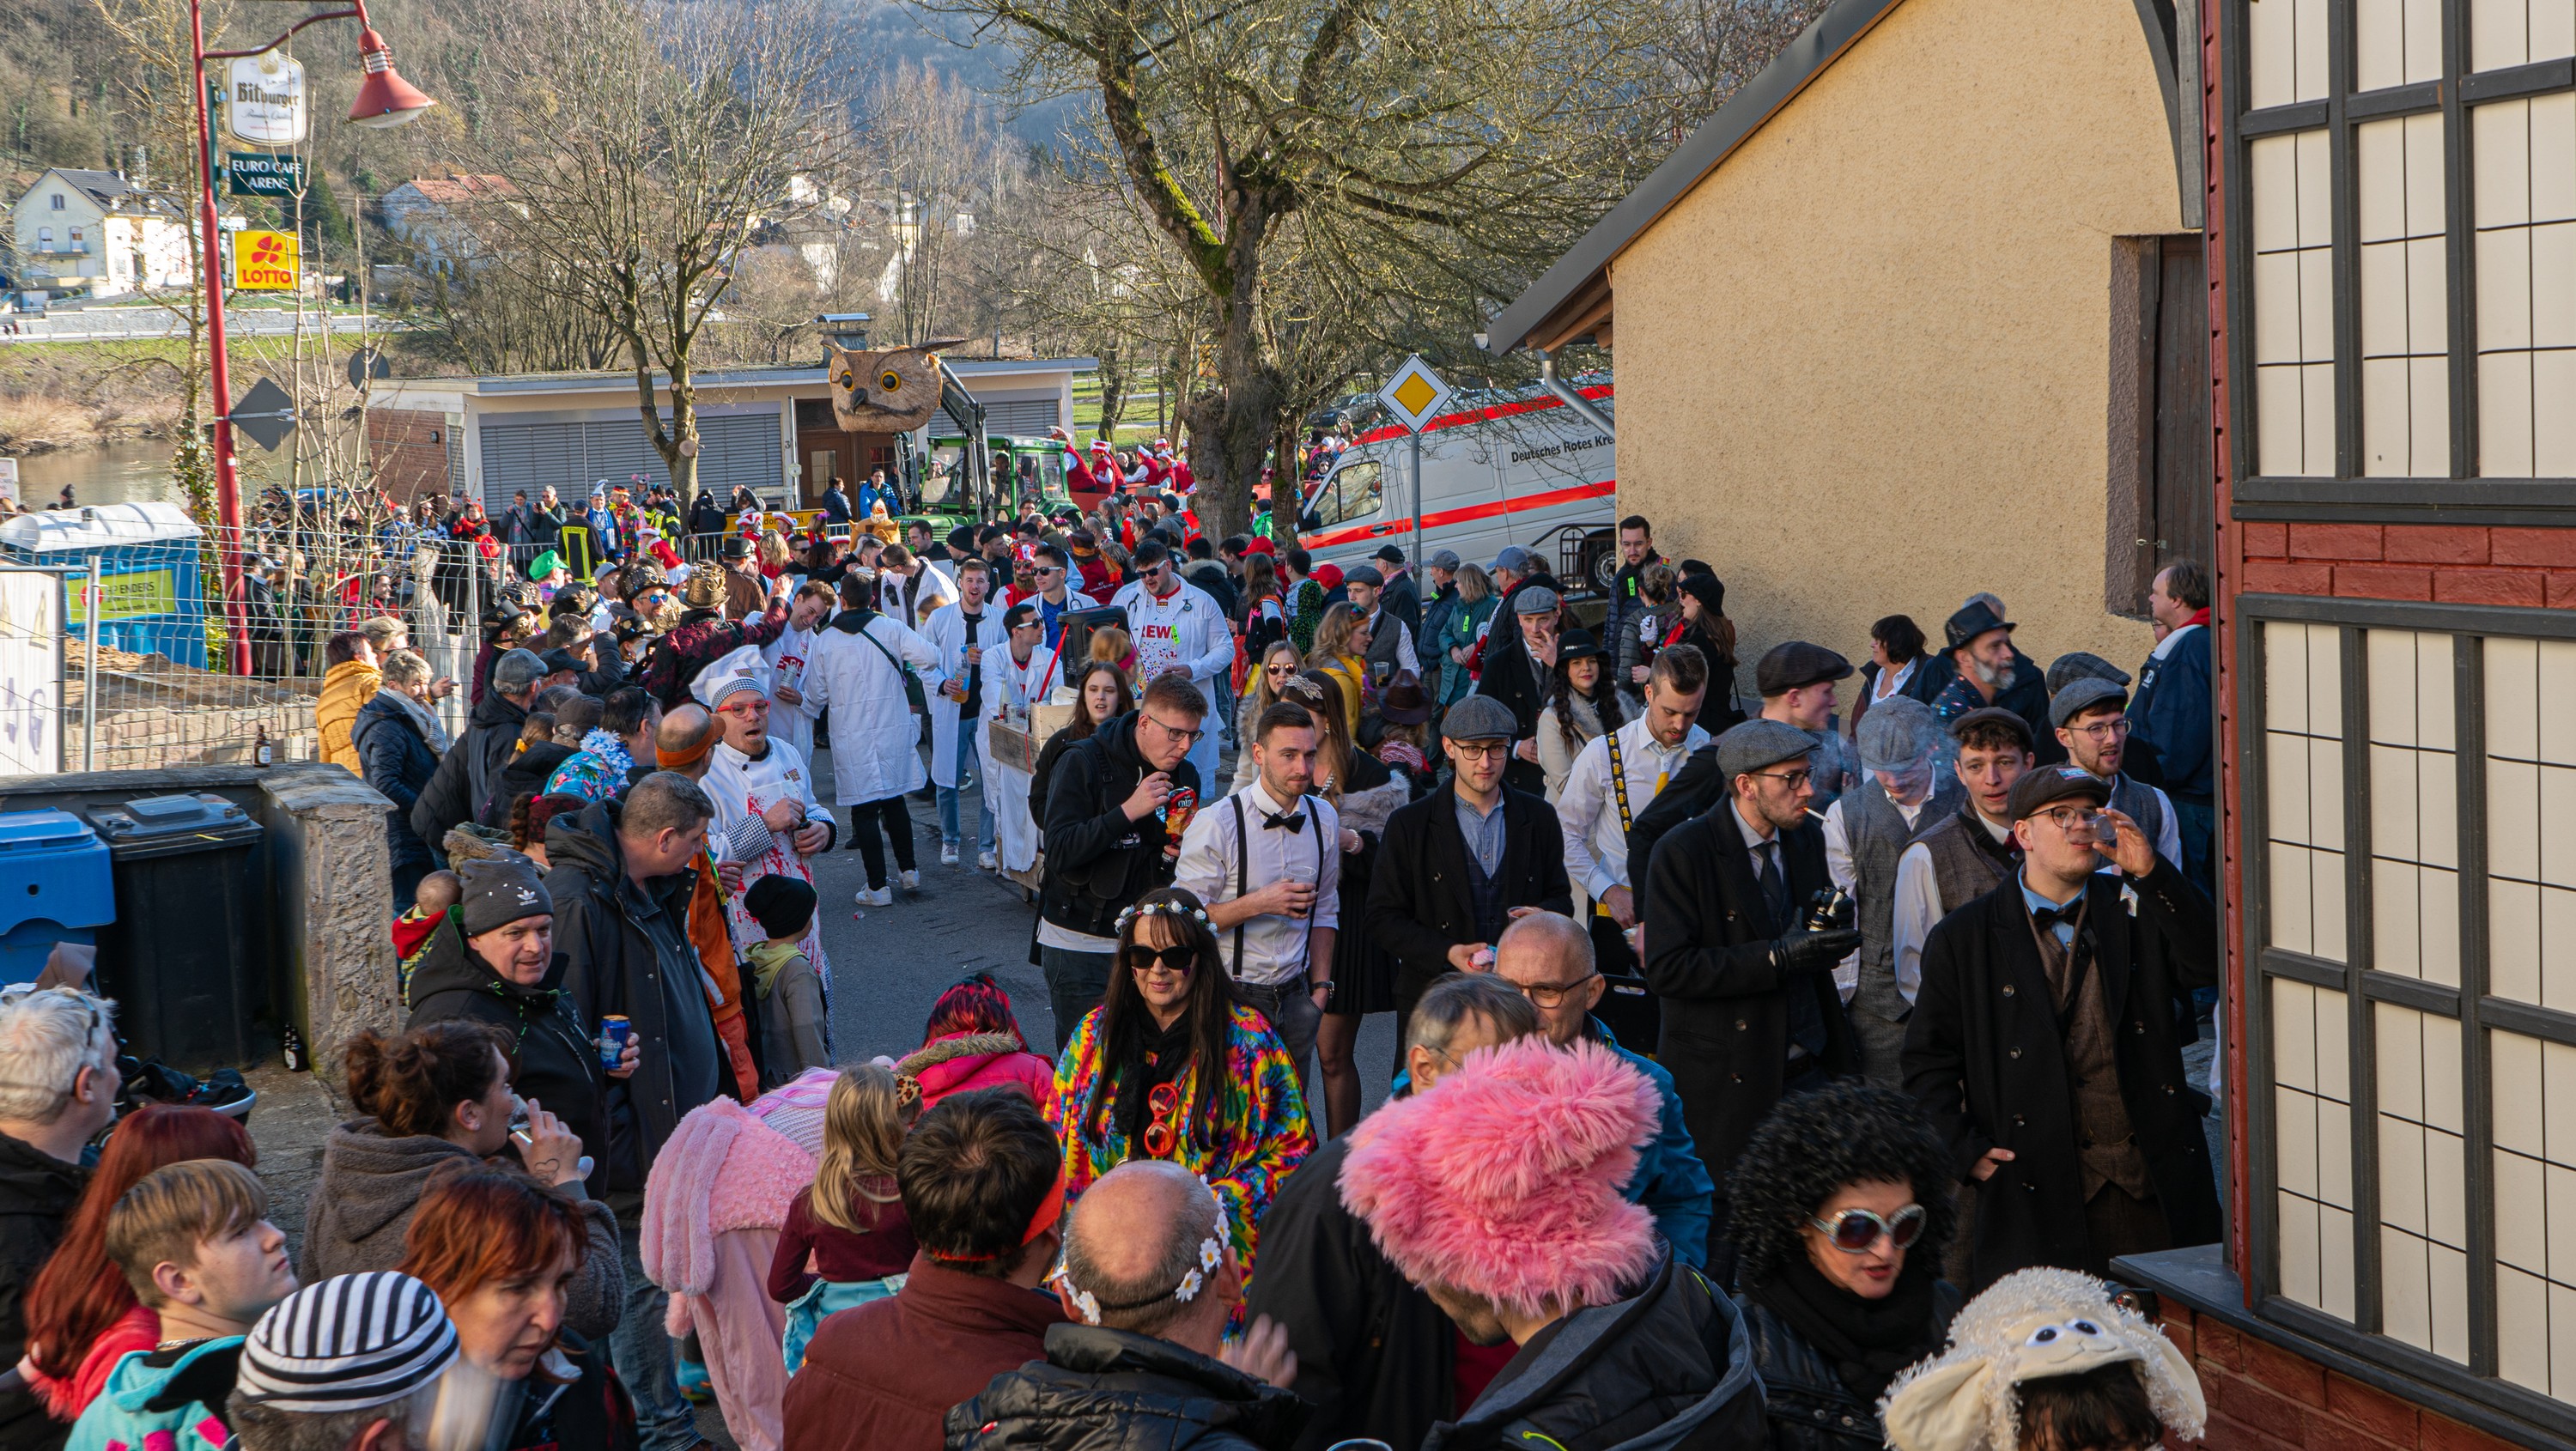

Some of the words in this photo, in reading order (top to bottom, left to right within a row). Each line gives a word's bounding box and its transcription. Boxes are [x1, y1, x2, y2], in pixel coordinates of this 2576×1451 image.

[236, 82, 299, 107] Bitburger
[232, 160, 270, 173] EURO
[271, 162, 302, 174] CAFE
[249, 177, 289, 190] ARENS
[243, 270, 291, 283] LOTTO
[785, 440, 791, 449] 3
[1511, 446, 1561, 463] Deutsches
[1563, 439, 1592, 452] Rotes
[1595, 434, 1615, 446] Kre
[120, 582, 155, 594] ENDERS
